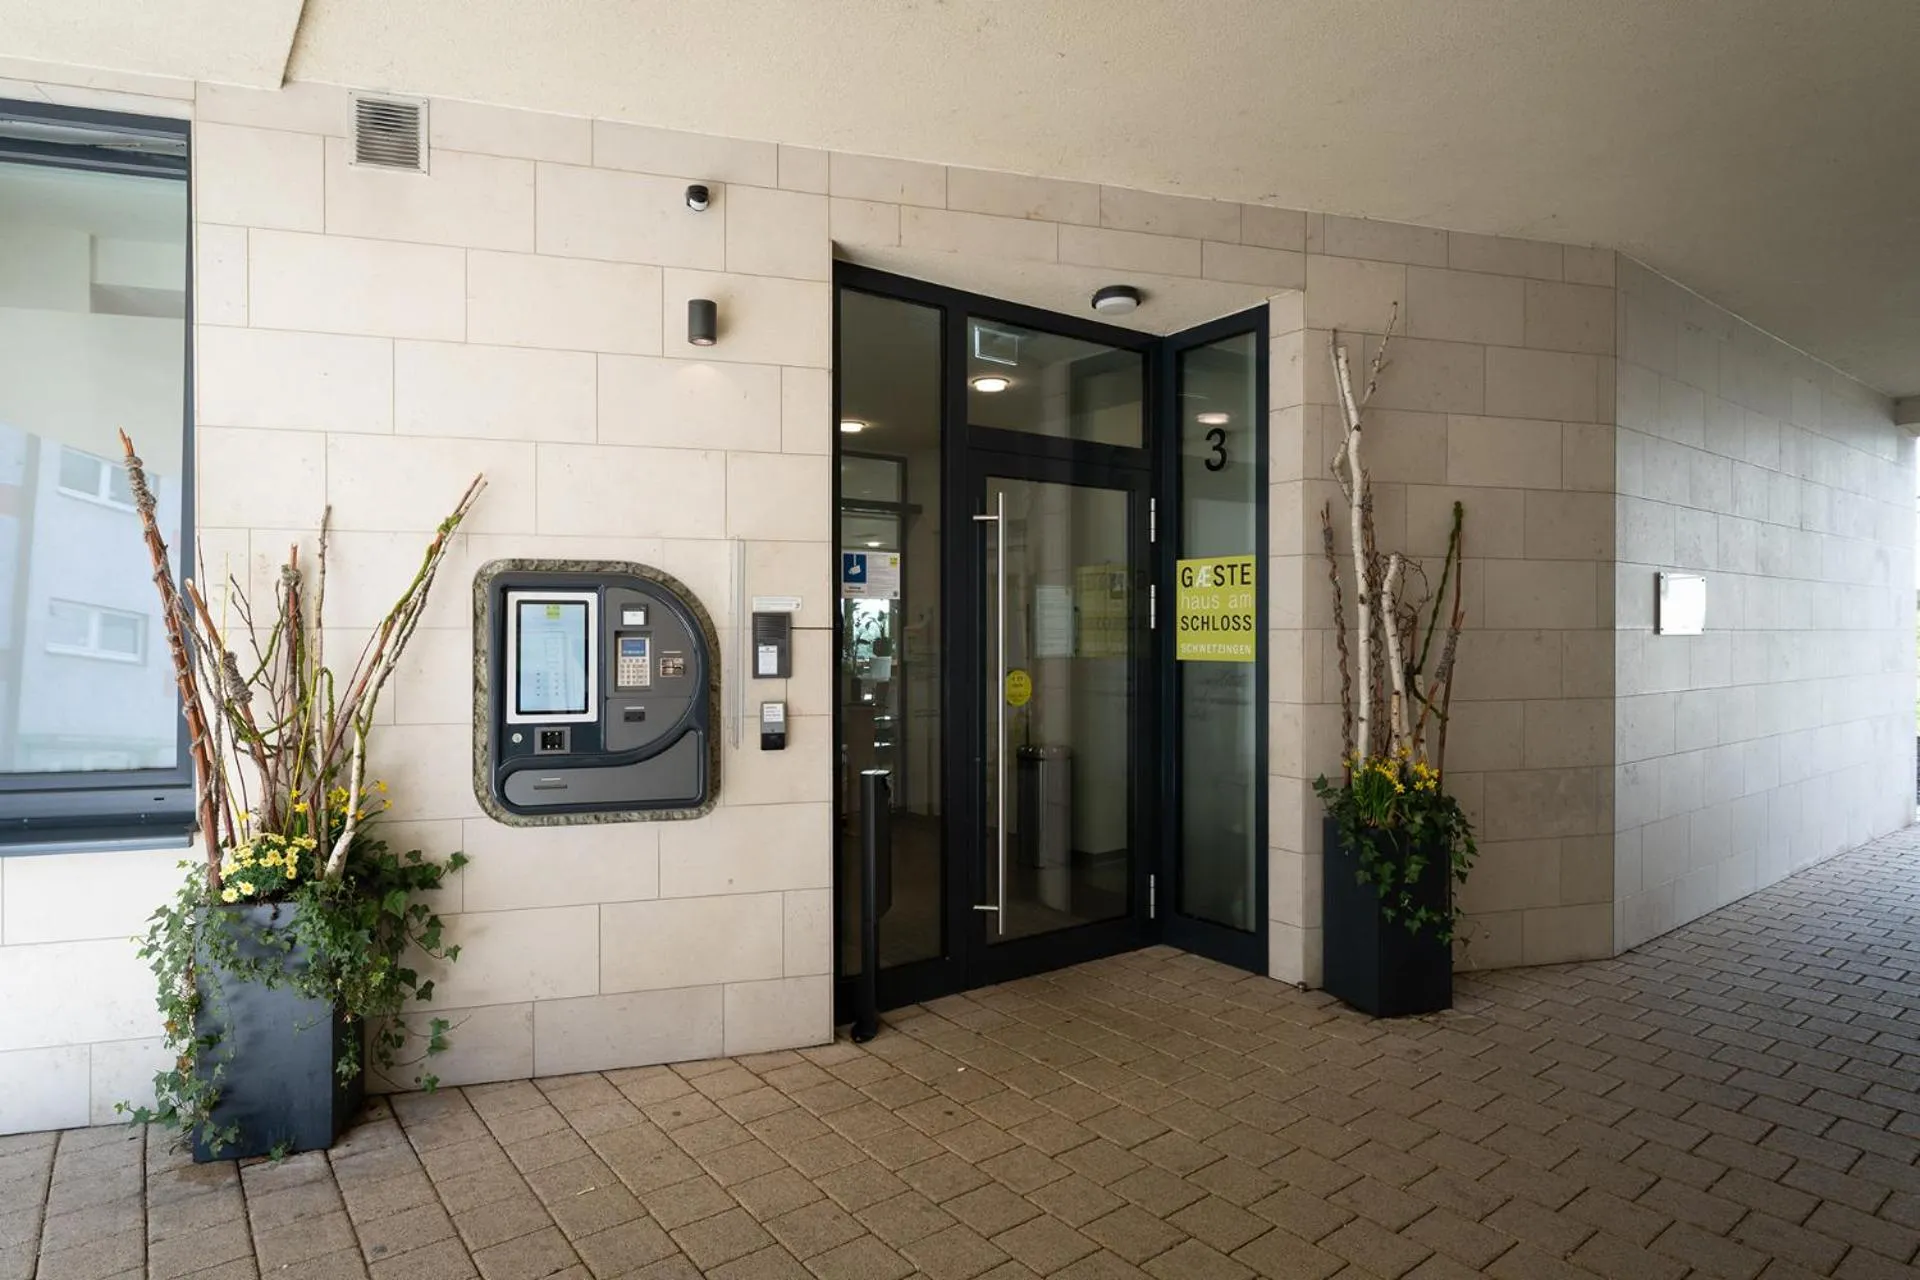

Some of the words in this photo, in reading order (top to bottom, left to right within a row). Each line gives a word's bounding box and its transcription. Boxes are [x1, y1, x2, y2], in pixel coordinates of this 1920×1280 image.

[1204, 428, 1227, 472] 3
[1181, 563, 1252, 588] GÆSTE
[1182, 592, 1220, 610] haus
[1228, 591, 1252, 609] am
[1181, 614, 1252, 631] SCHLOSS
